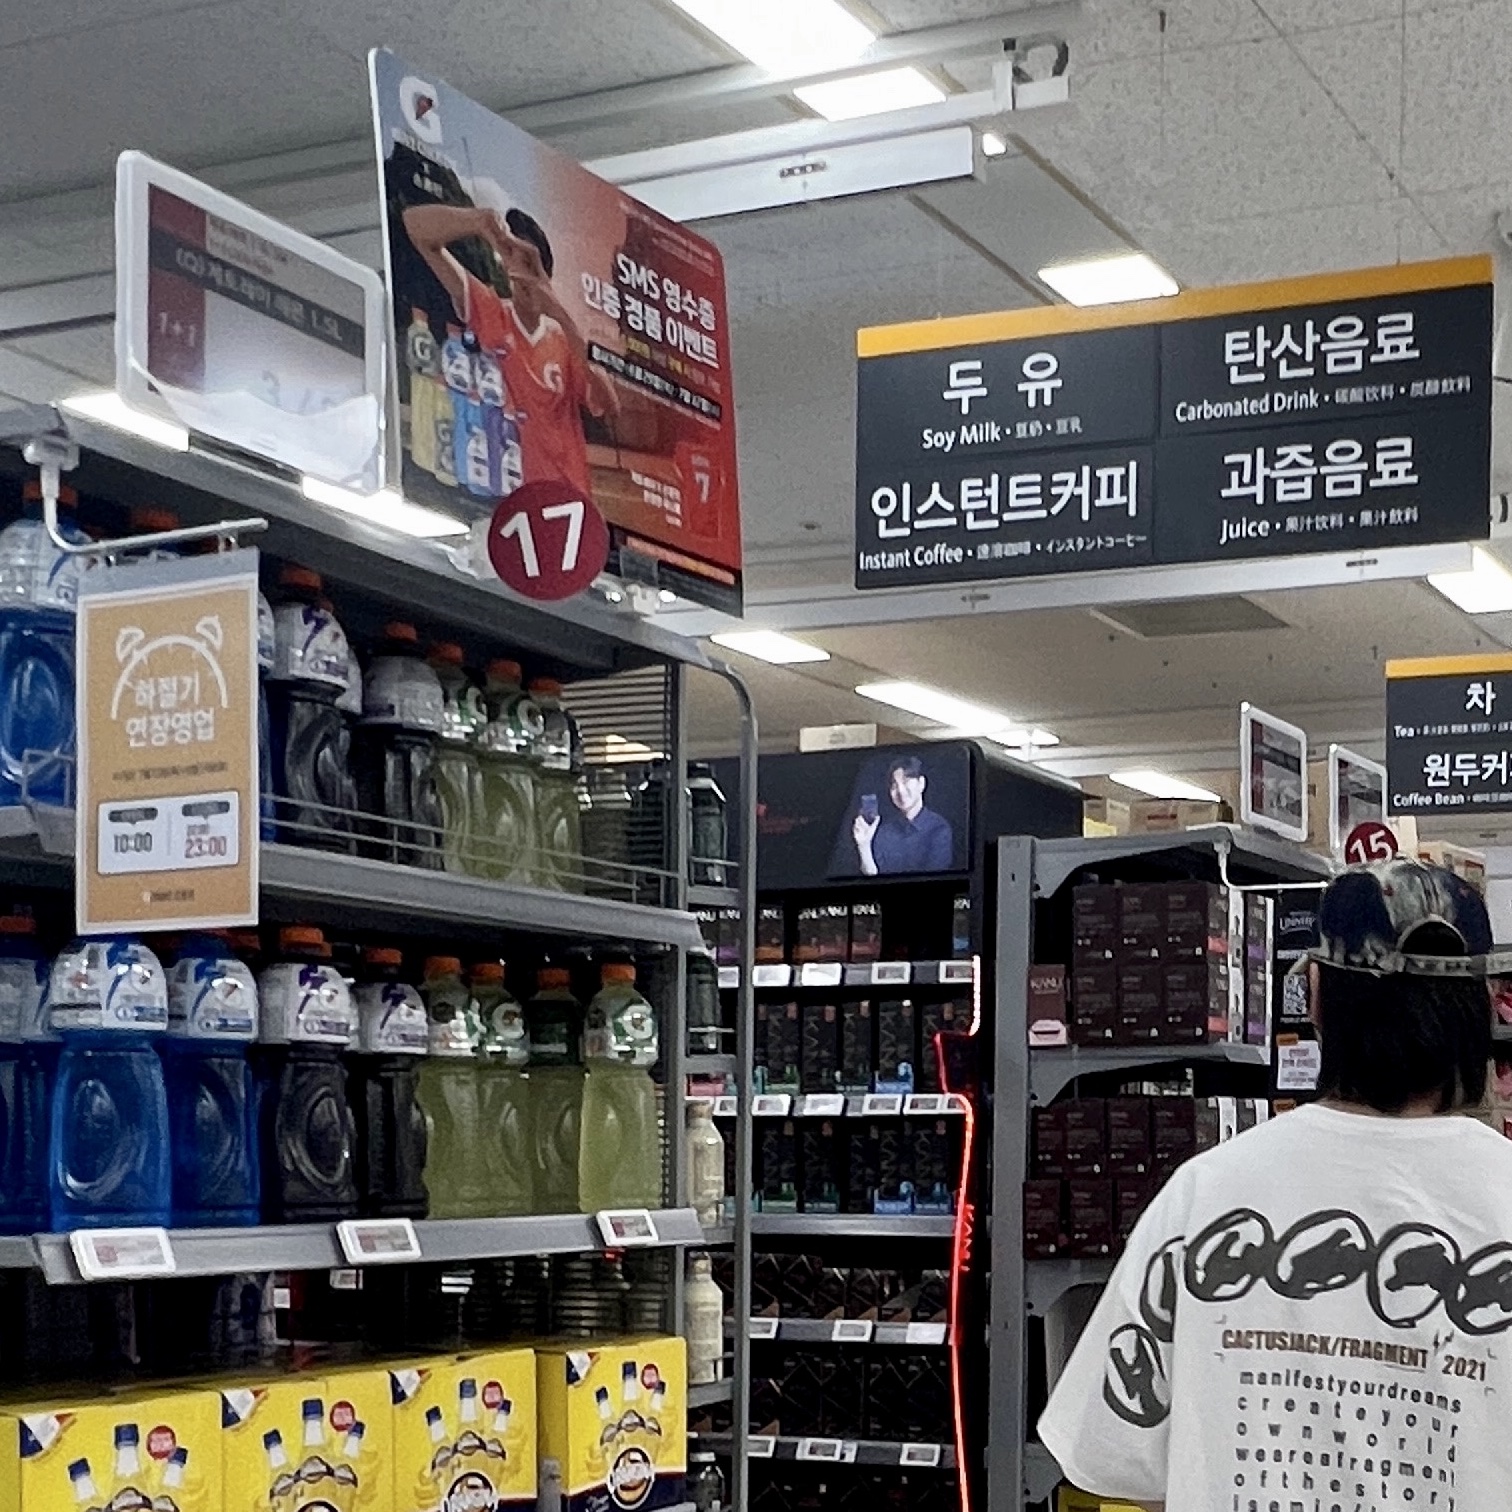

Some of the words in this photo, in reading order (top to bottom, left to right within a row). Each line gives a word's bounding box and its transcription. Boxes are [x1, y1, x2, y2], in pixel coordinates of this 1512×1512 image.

[616, 252, 661, 300] SMS
[663, 277, 717, 332] 영수증
[580, 272, 623, 320] 인증
[624, 296, 663, 343] 경품
[665, 321, 720, 369] 이벤트
[1224, 311, 1421, 385] 탄산음료
[943, 359, 988, 415] 두
[1017, 351, 1063, 408] 유
[1175, 393, 1270, 422] Carbonated
[1273, 387, 1320, 412] Drink
[922, 428, 955, 452] Soy
[960, 421, 1001, 445] Milk
[1220, 435, 1420, 505] 과즙음료
[870, 459, 1138, 539] 인스턴트커피
[501, 502, 585, 578] 17
[1219, 517, 1270, 544] Juice
[859, 549, 911, 571] Instant
[913, 542, 964, 567] Coffee
[1464, 680, 1497, 716] 차
[125, 707, 216, 748] 연장영업
[1394, 725, 1416, 739] Tea
[1393, 791, 1433, 808] Coffee
[1435, 791, 1465, 806] Bean
[113, 831, 153, 854] 10:00
[1441, 1353, 1487, 1382] 2021
